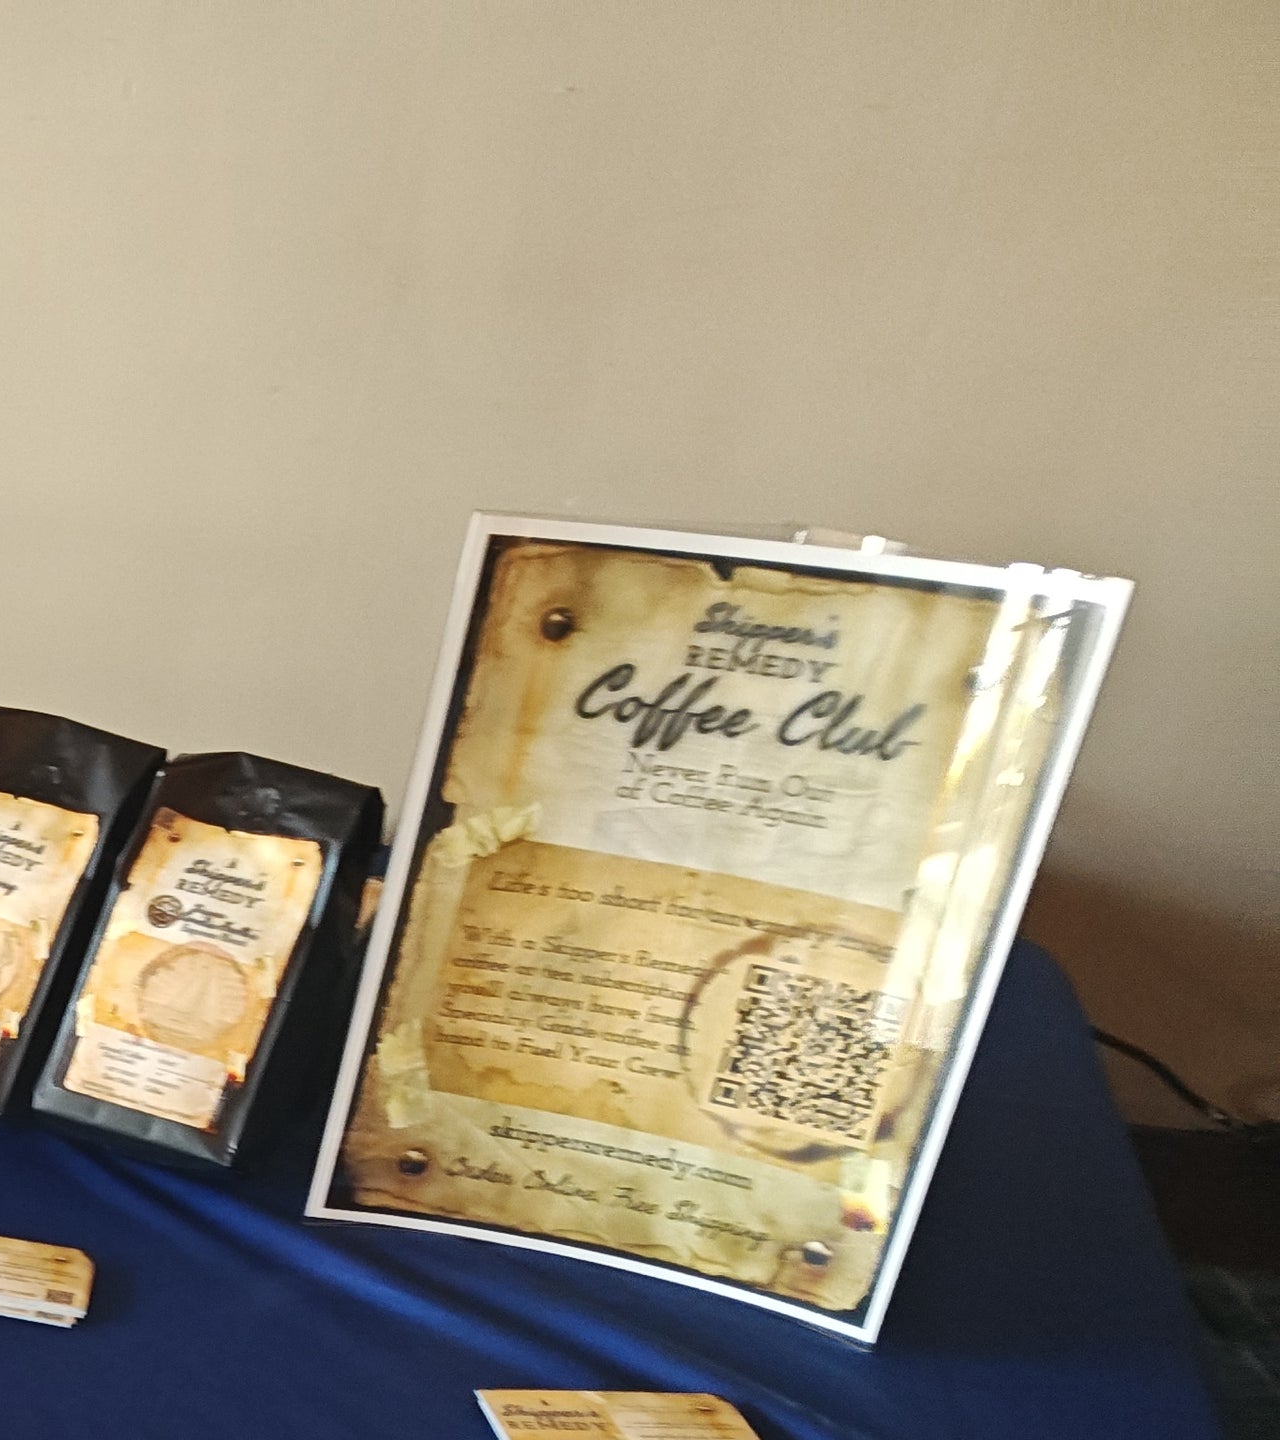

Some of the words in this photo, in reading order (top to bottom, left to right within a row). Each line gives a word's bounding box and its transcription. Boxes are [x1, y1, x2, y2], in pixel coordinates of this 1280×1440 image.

[575, 663, 760, 751] Coffee
[777, 689, 929, 762] Club
[490, 1115, 753, 1190] skippersremedy.com
